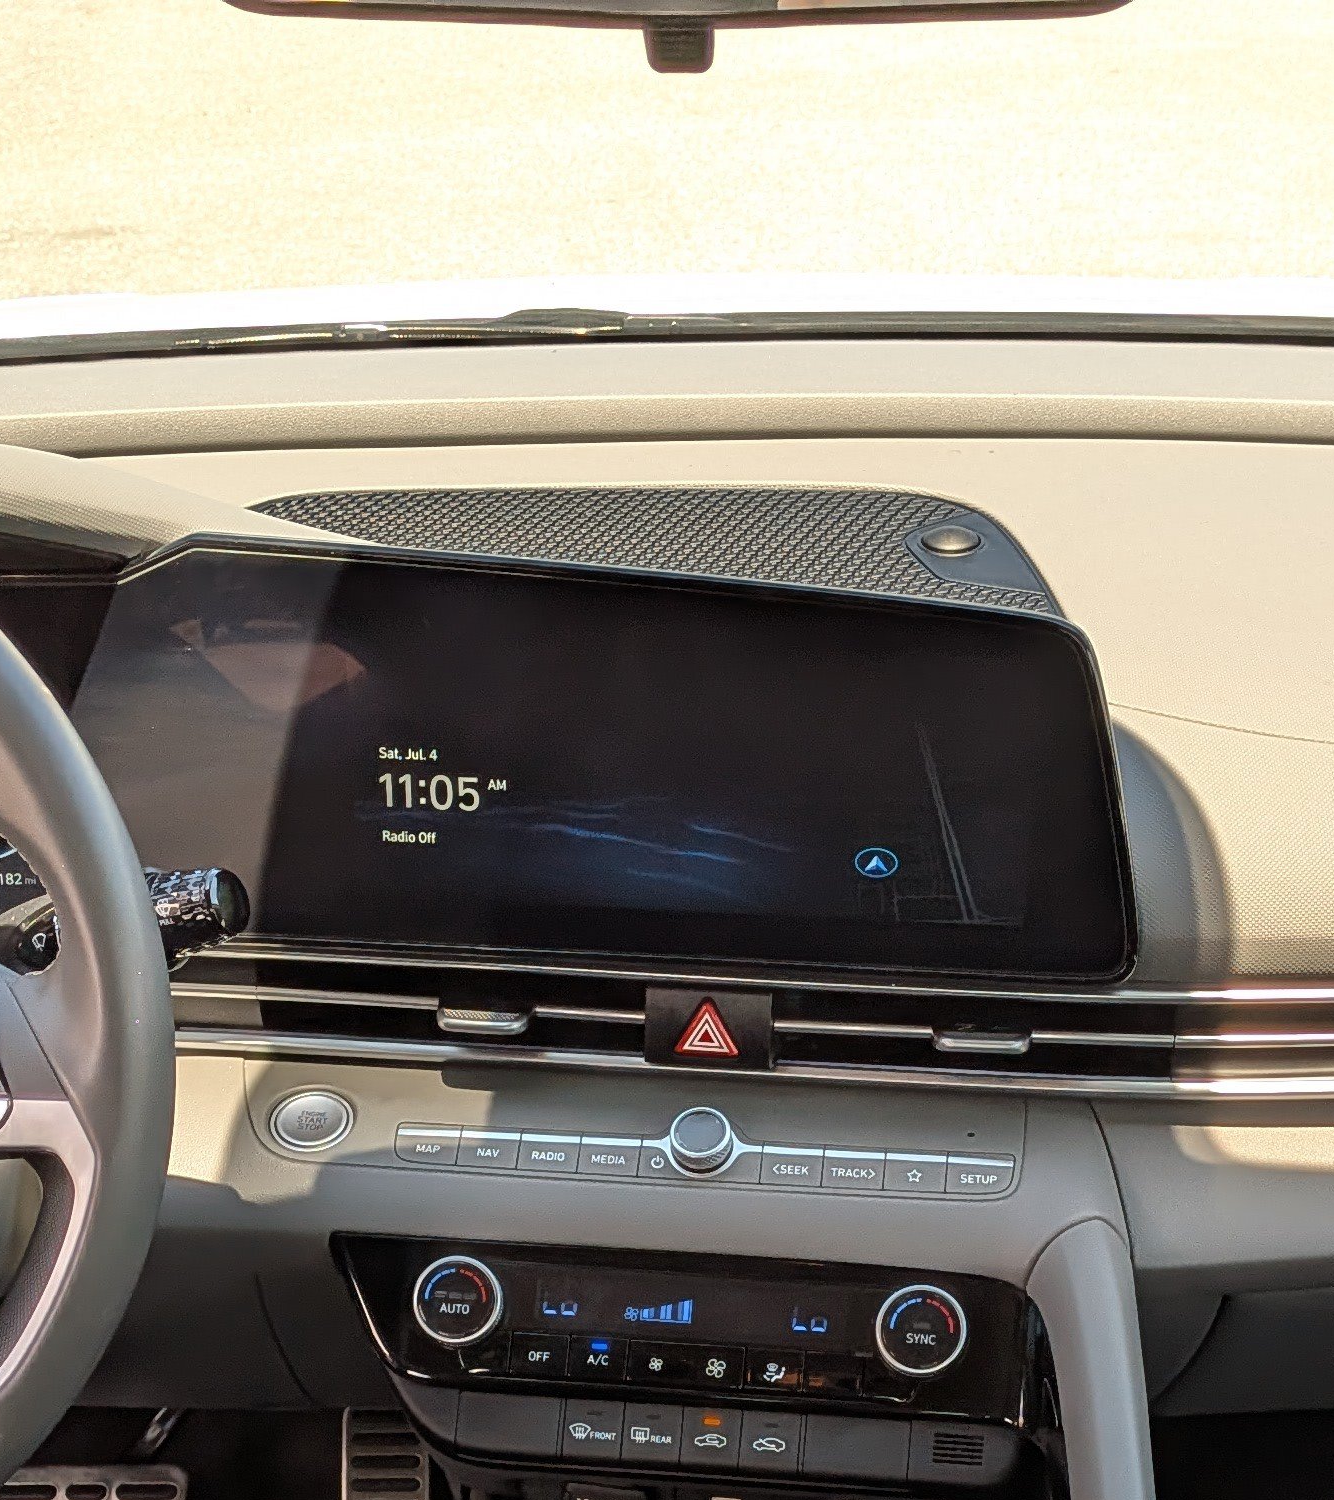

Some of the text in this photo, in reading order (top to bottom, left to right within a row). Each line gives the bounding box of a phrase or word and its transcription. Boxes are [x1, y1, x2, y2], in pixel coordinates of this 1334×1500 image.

[428, 748, 438, 761] 4
[378, 772, 507, 812] 11:05 AM
[381, 829, 437, 844] Radio Off
[297, 1115, 328, 1124] START
[297, 1123, 324, 1131] STOP
[415, 1144, 441, 1154] MAP
[476, 1147, 500, 1158] NAV
[531, 1150, 566, 1162] RADIO
[590, 1154, 626, 1165] MEDIA
[960, 1173, 998, 1184] SETUP
[439, 1303, 470, 1315] AUTO
[905, 1332, 937, 1346] SYNC
[528, 1350, 551, 1362] OFF
[586, 1353, 609, 1366] A/C
[589, 1430, 617, 1441] FRONT
[650, 1434, 672, 1445] REAR
